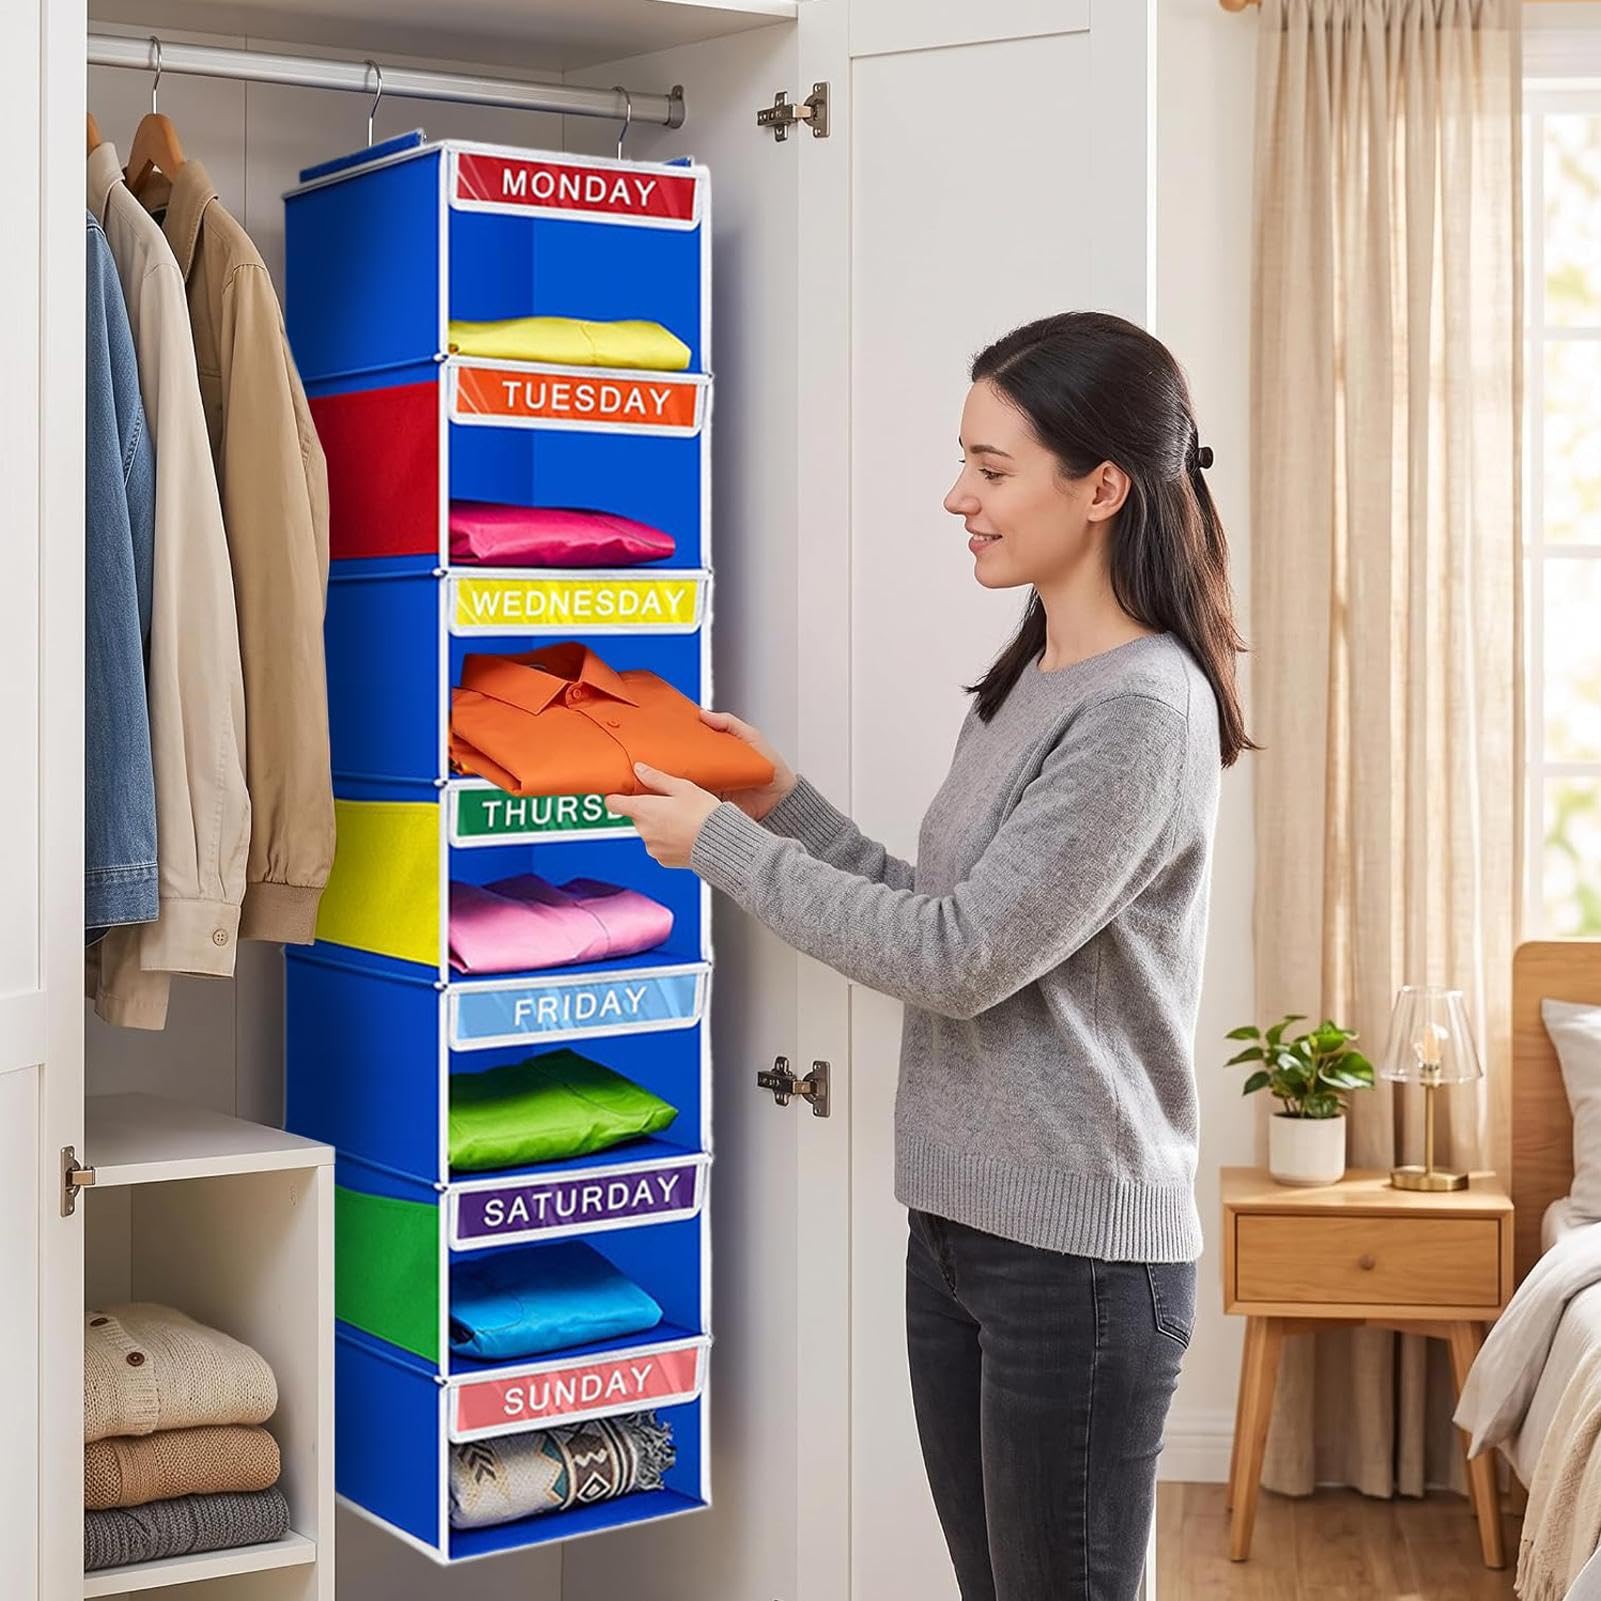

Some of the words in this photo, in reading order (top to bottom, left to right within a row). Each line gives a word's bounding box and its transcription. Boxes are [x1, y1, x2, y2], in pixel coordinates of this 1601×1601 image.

[502, 168, 656, 206] MONDAY
[502, 380, 672, 415] TUESDAY
[471, 589, 685, 617] WEDNESDAY
[482, 794, 624, 828] THURS
[514, 986, 647, 1026] FRIDAY
[483, 1174, 679, 1227] SATURDAY
[503, 1364, 652, 1415] SUNDAY
